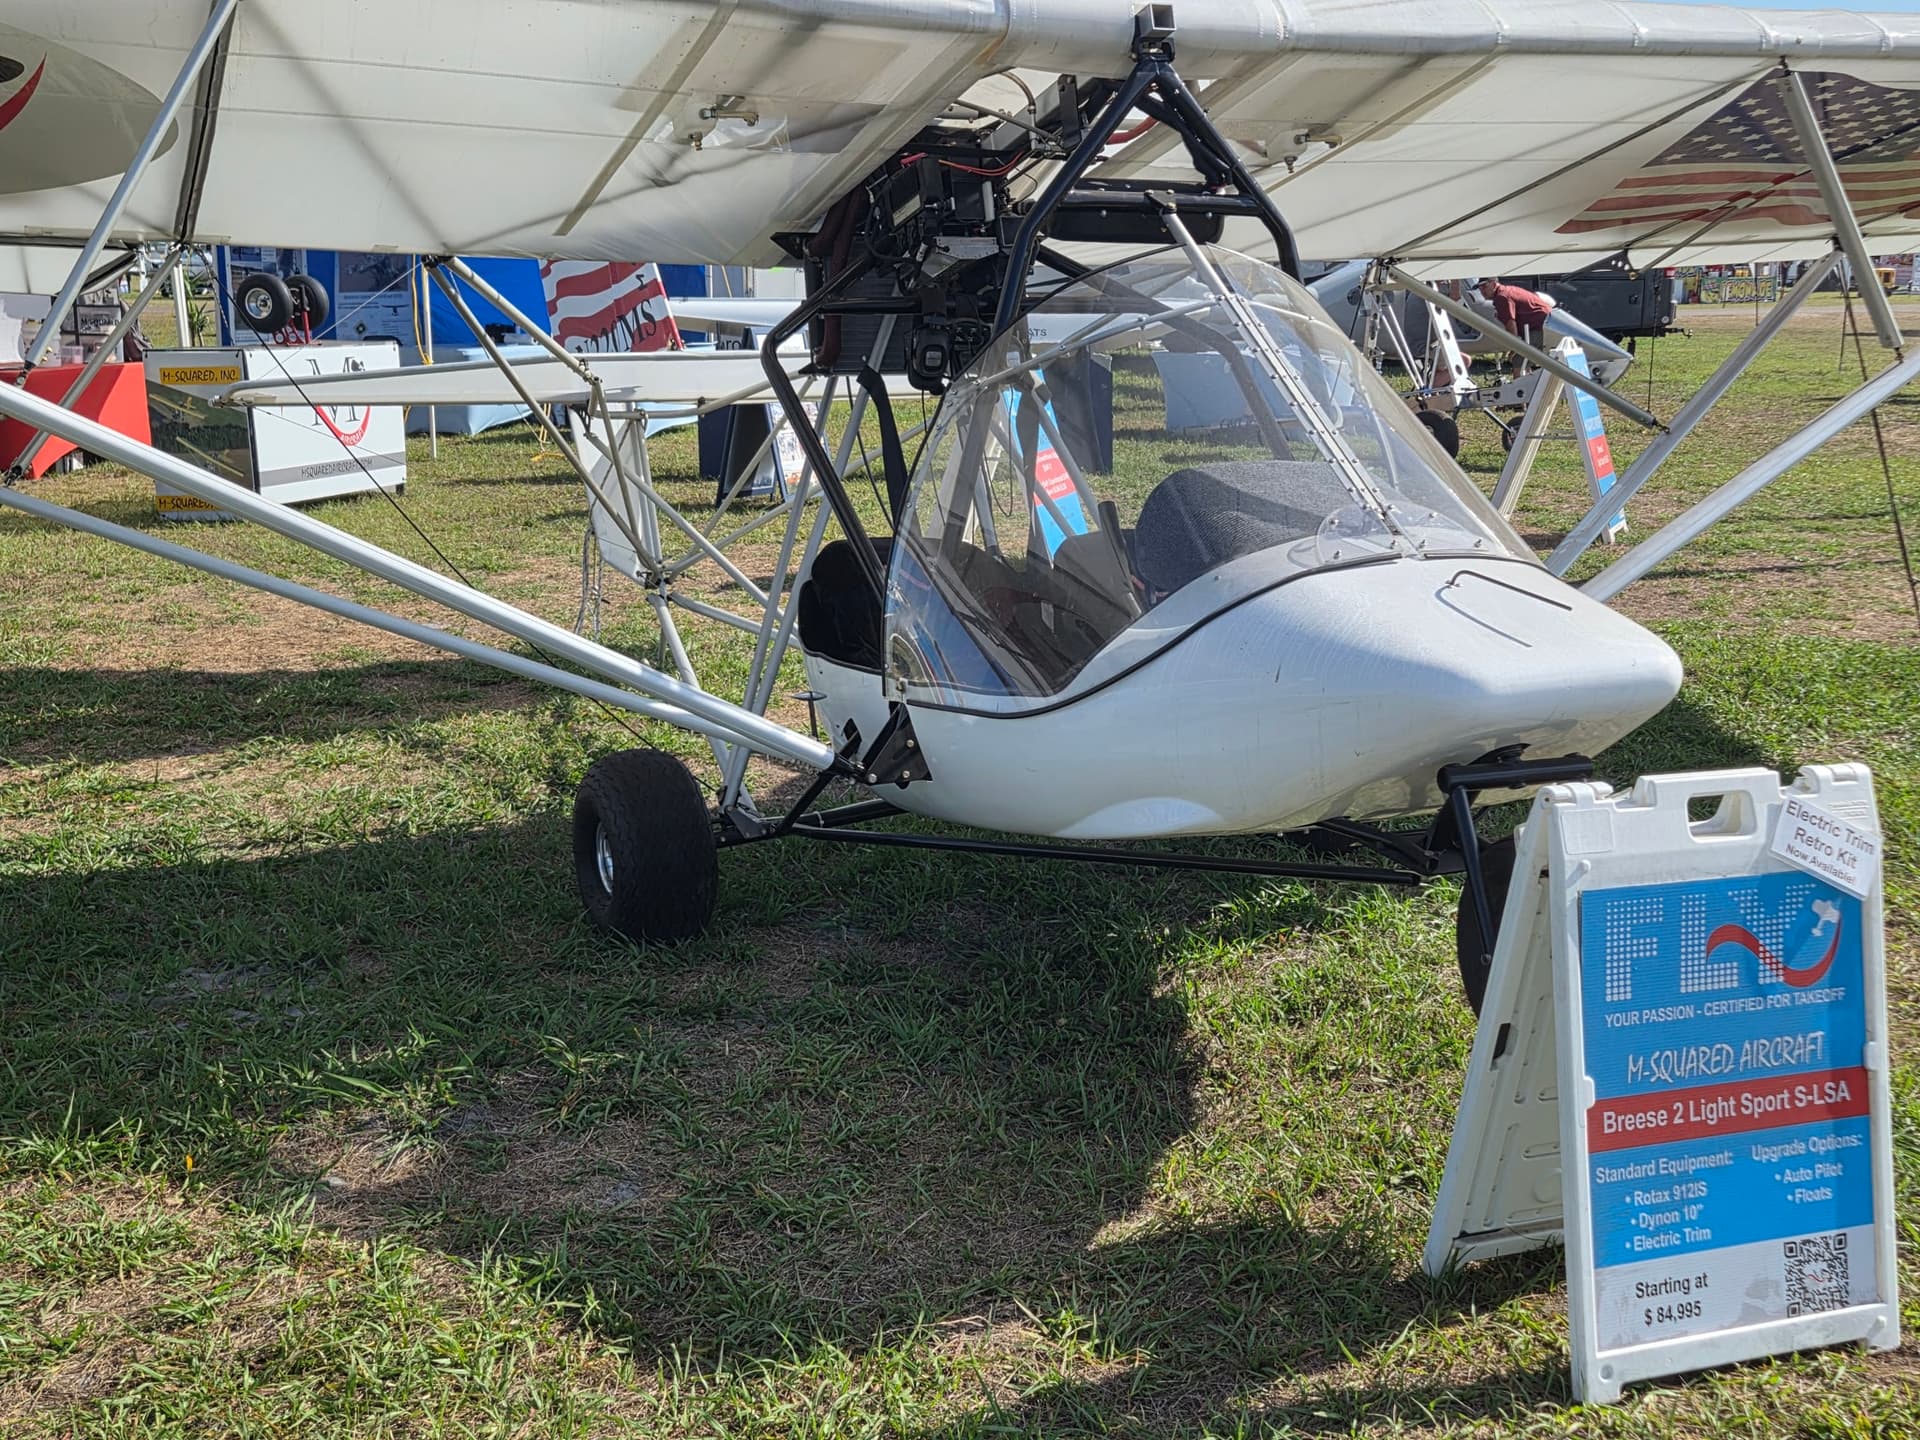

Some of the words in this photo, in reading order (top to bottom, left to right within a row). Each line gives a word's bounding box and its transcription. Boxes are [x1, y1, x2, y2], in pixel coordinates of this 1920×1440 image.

[162, 370, 218, 383] M-SQUARED,
[220, 369, 238, 381] INC.
[1786, 800, 1841, 837] Electric
[1845, 828, 1875, 855] Trim
[1794, 827, 1833, 856] Retro
[1836, 847, 1857, 869] Kit
[1785, 844, 1808, 861] Now
[1808, 855, 1857, 885] Available!
[1605, 884, 1818, 1002] FLY
[1605, 1012, 1639, 1028] YOUR
[1642, 1005, 1694, 1024] PASSION
[1704, 997, 1764, 1017] CERTIFIED
[1767, 992, 1793, 1009] FOR
[1794, 987, 1846, 1006] TAKEOFF
[1627, 1043, 1735, 1084] M-SQUARED
[1739, 1031, 1825, 1073] AIRCRAFT
[1603, 1108, 1668, 1134] Breese
[1673, 1102, 1685, 1125] 2
[1690, 1096, 1736, 1125] Light
[1740, 1089, 1790, 1119] Sport
[1794, 1080, 1851, 1108] S-LSA
[1751, 1139, 1807, 1163] Upgrade
[1808, 1133, 1863, 1155] Options:
[1596, 1160, 1656, 1184] Standard
[1659, 1150, 1734, 1176] Equipment:
[1783, 1168, 1813, 1184] Auto
[1815, 1162, 1844, 1179] Pilot
[1634, 1189, 1670, 1206] Rotax
[1794, 1186, 1833, 1204] Floats
[1639, 1211, 1680, 1231] Dynon
[1683, 1203, 1704, 1220] 10"
[1633, 1231, 1681, 1251] Electric
[1683, 1226, 1712, 1243] Trim
[1635, 1276, 1690, 1299] Starting
[1695, 1272, 1708, 1289] at
[1644, 1308, 1653, 1327] $
[1657, 1300, 1702, 1323] 84,995
